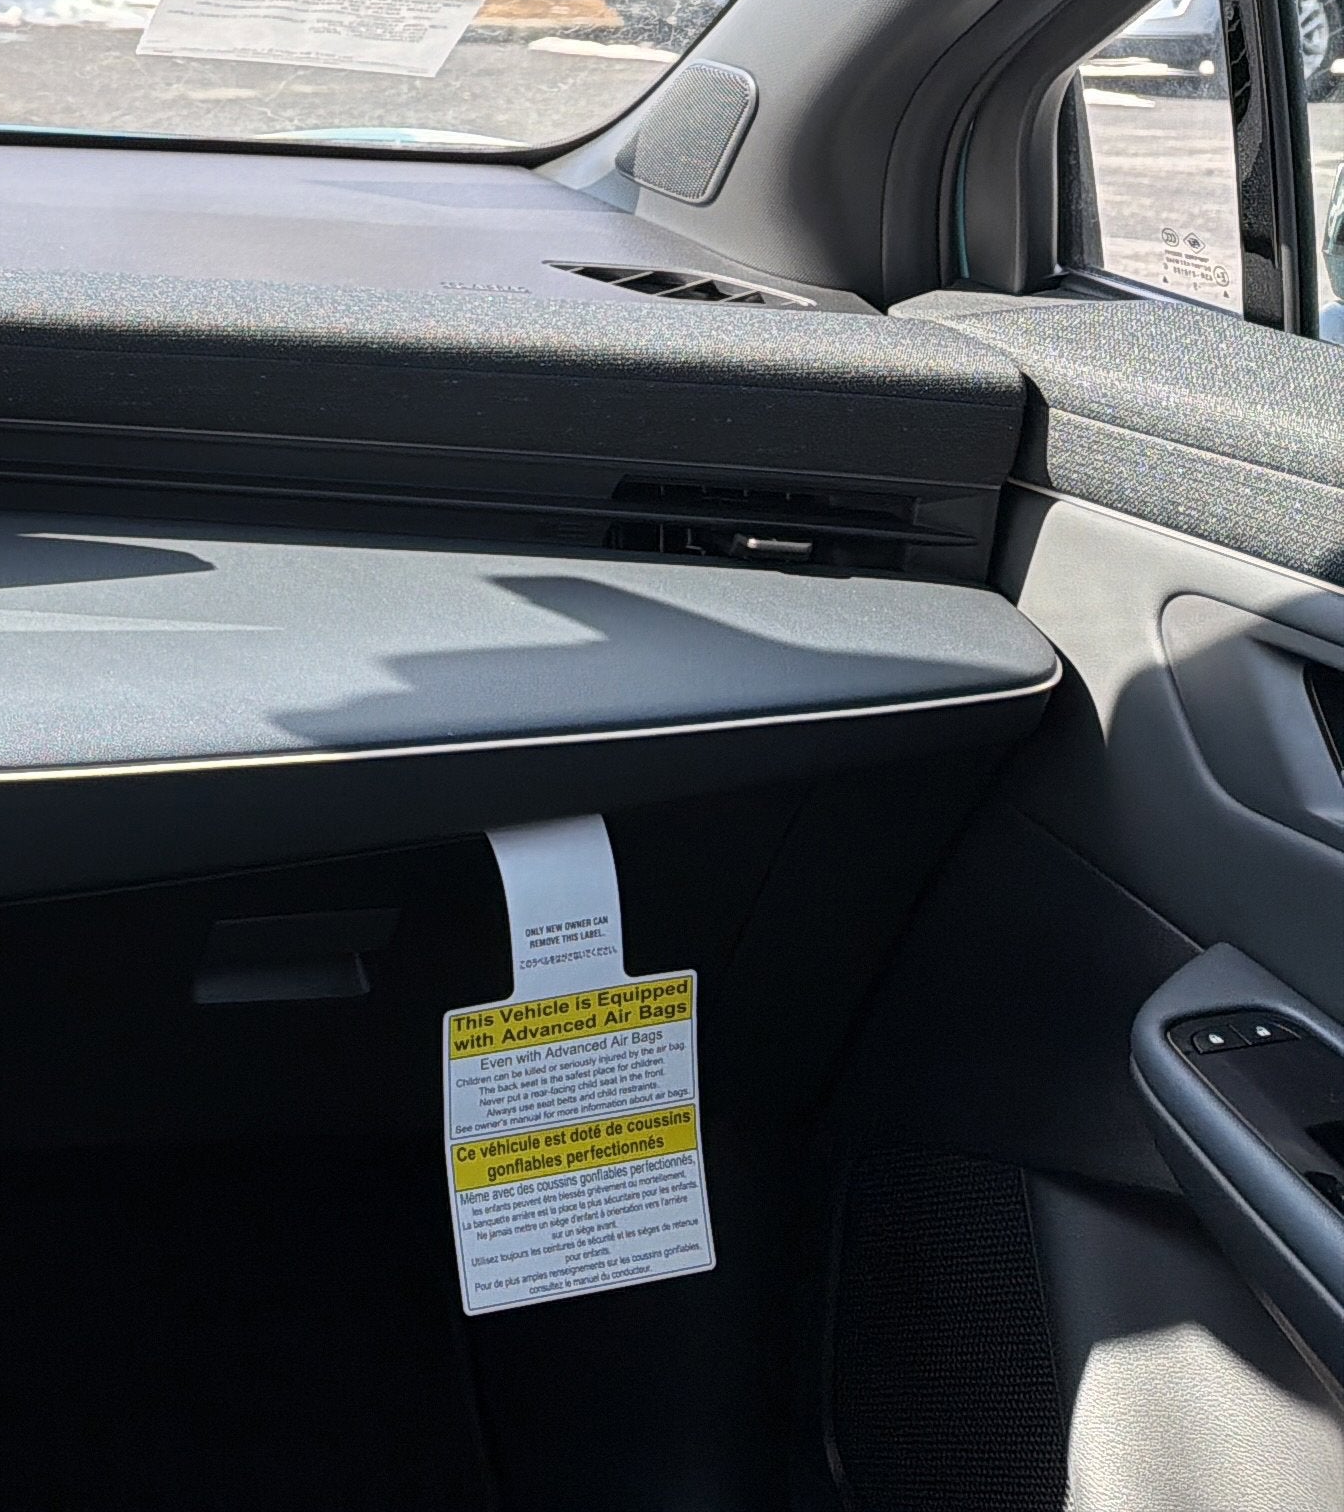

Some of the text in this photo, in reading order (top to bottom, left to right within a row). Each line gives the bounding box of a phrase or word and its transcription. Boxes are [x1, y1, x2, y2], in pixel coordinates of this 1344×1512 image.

[525, 915, 608, 937] ONLY NEW OWNER CAN
[530, 936, 560, 948] REMOVE
[562, 933, 579, 943] THIS
[453, 979, 688, 1033] This Vehicle is Equipped
[454, 1002, 687, 1052] with Advanced Air Bags
[456, 1075, 491, 1088] Children
[494, 1073, 509, 1082] can
[512, 1069, 522, 1078] be
[549, 1064, 557, 1072] or
[599, 1051, 627, 1064] injured
[629, 1049, 639, 1059] by
[641, 1046, 654, 1056] the
[480, 1030, 663, 1071] Even with Advanced Air Bags
[479, 1086, 496, 1095] The
[498, 1082, 518, 1092] back
[521, 1079, 538, 1088] seat
[541, 1077, 547, 1085] is
[550, 1076, 563, 1084] the
[565, 1069, 591, 1081] safest
[593, 1066, 615, 1077] place
[618, 1063, 628, 1071] for
[457, 1110, 691, 1163] Ce véhicule est doté de coussins
[460, 1154, 696, 1205] Même avec des coussins gonflables perfectionnés,
[487, 1136, 665, 1182] gonflables perfectionnés
